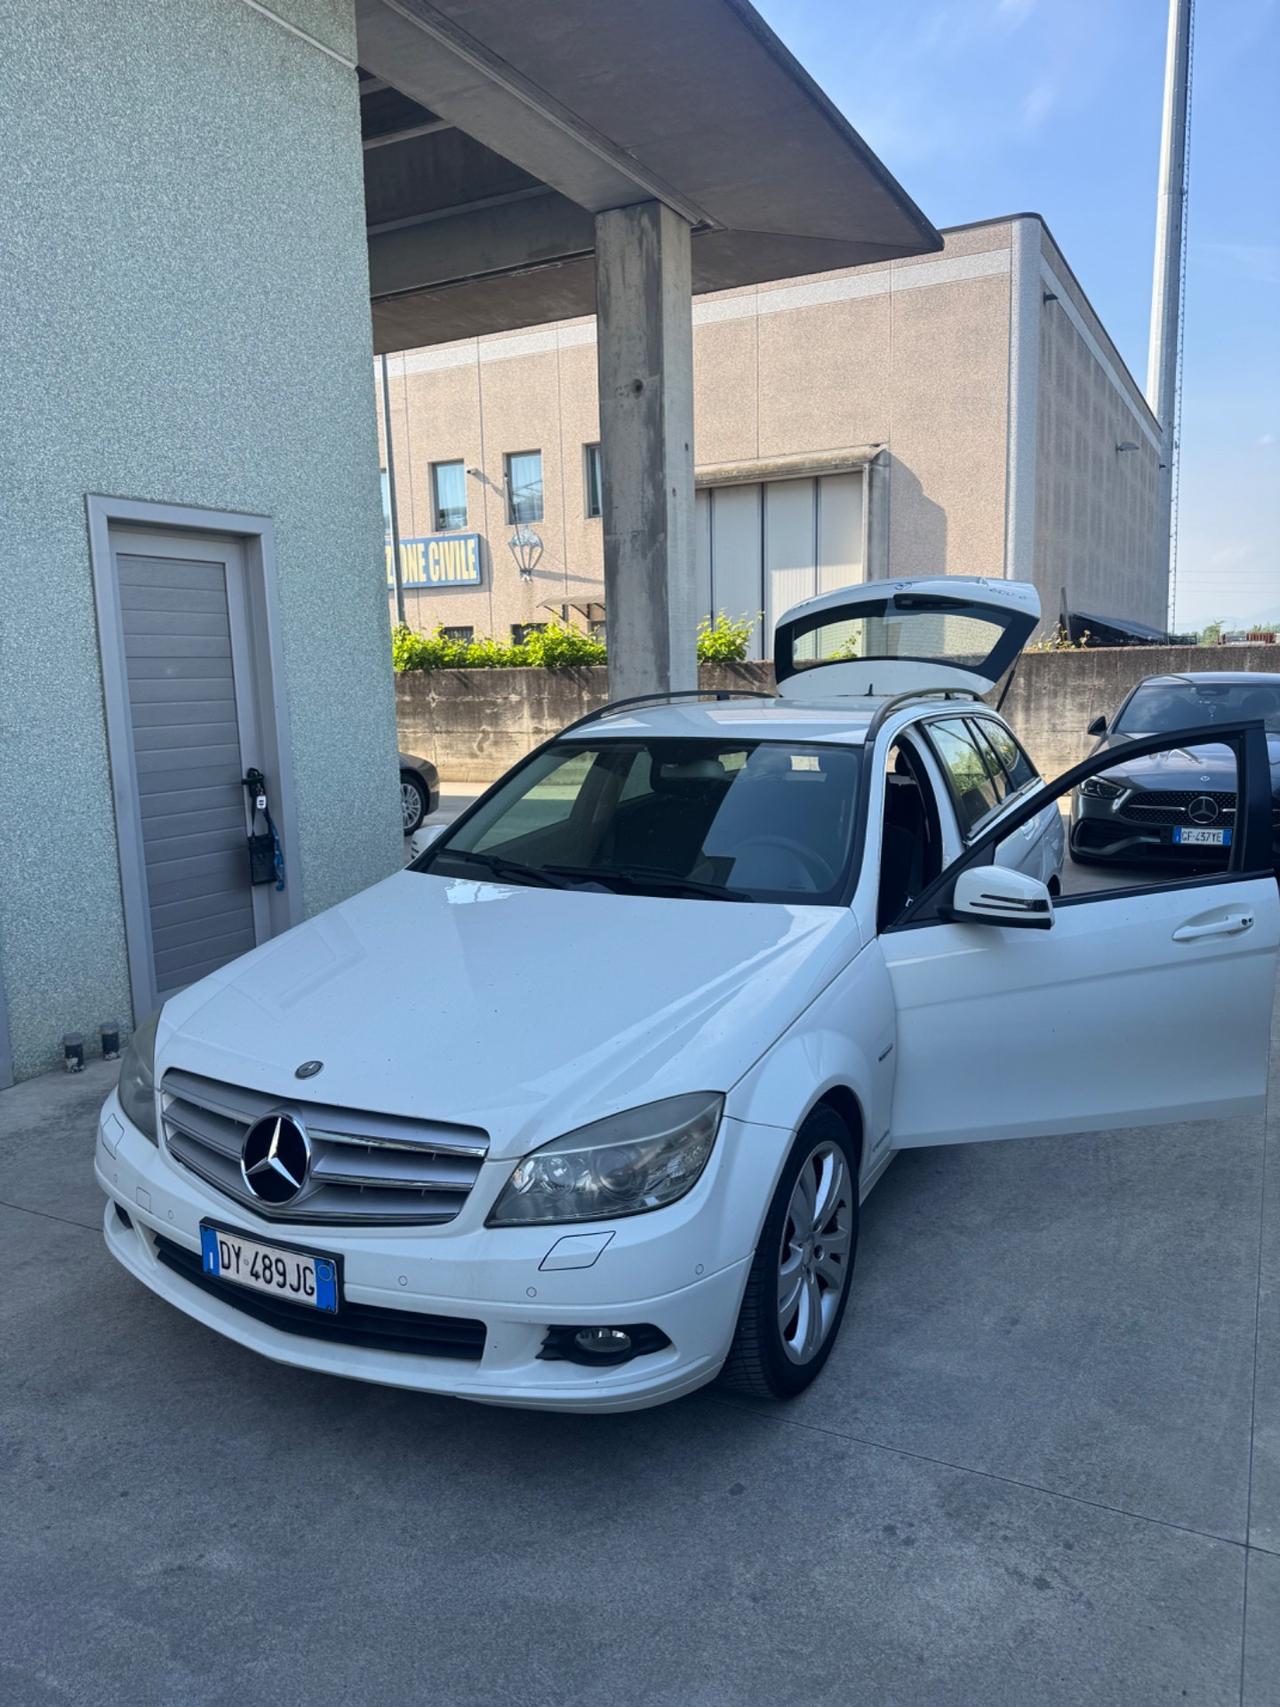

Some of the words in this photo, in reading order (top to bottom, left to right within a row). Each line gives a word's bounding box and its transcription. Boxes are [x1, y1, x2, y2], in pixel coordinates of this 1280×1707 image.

[385, 543, 427, 585] ZONE
[428, 539, 477, 582] CIVILE
[220, 1240, 242, 1275] DY
[250, 1251, 316, 1297] 489JG
